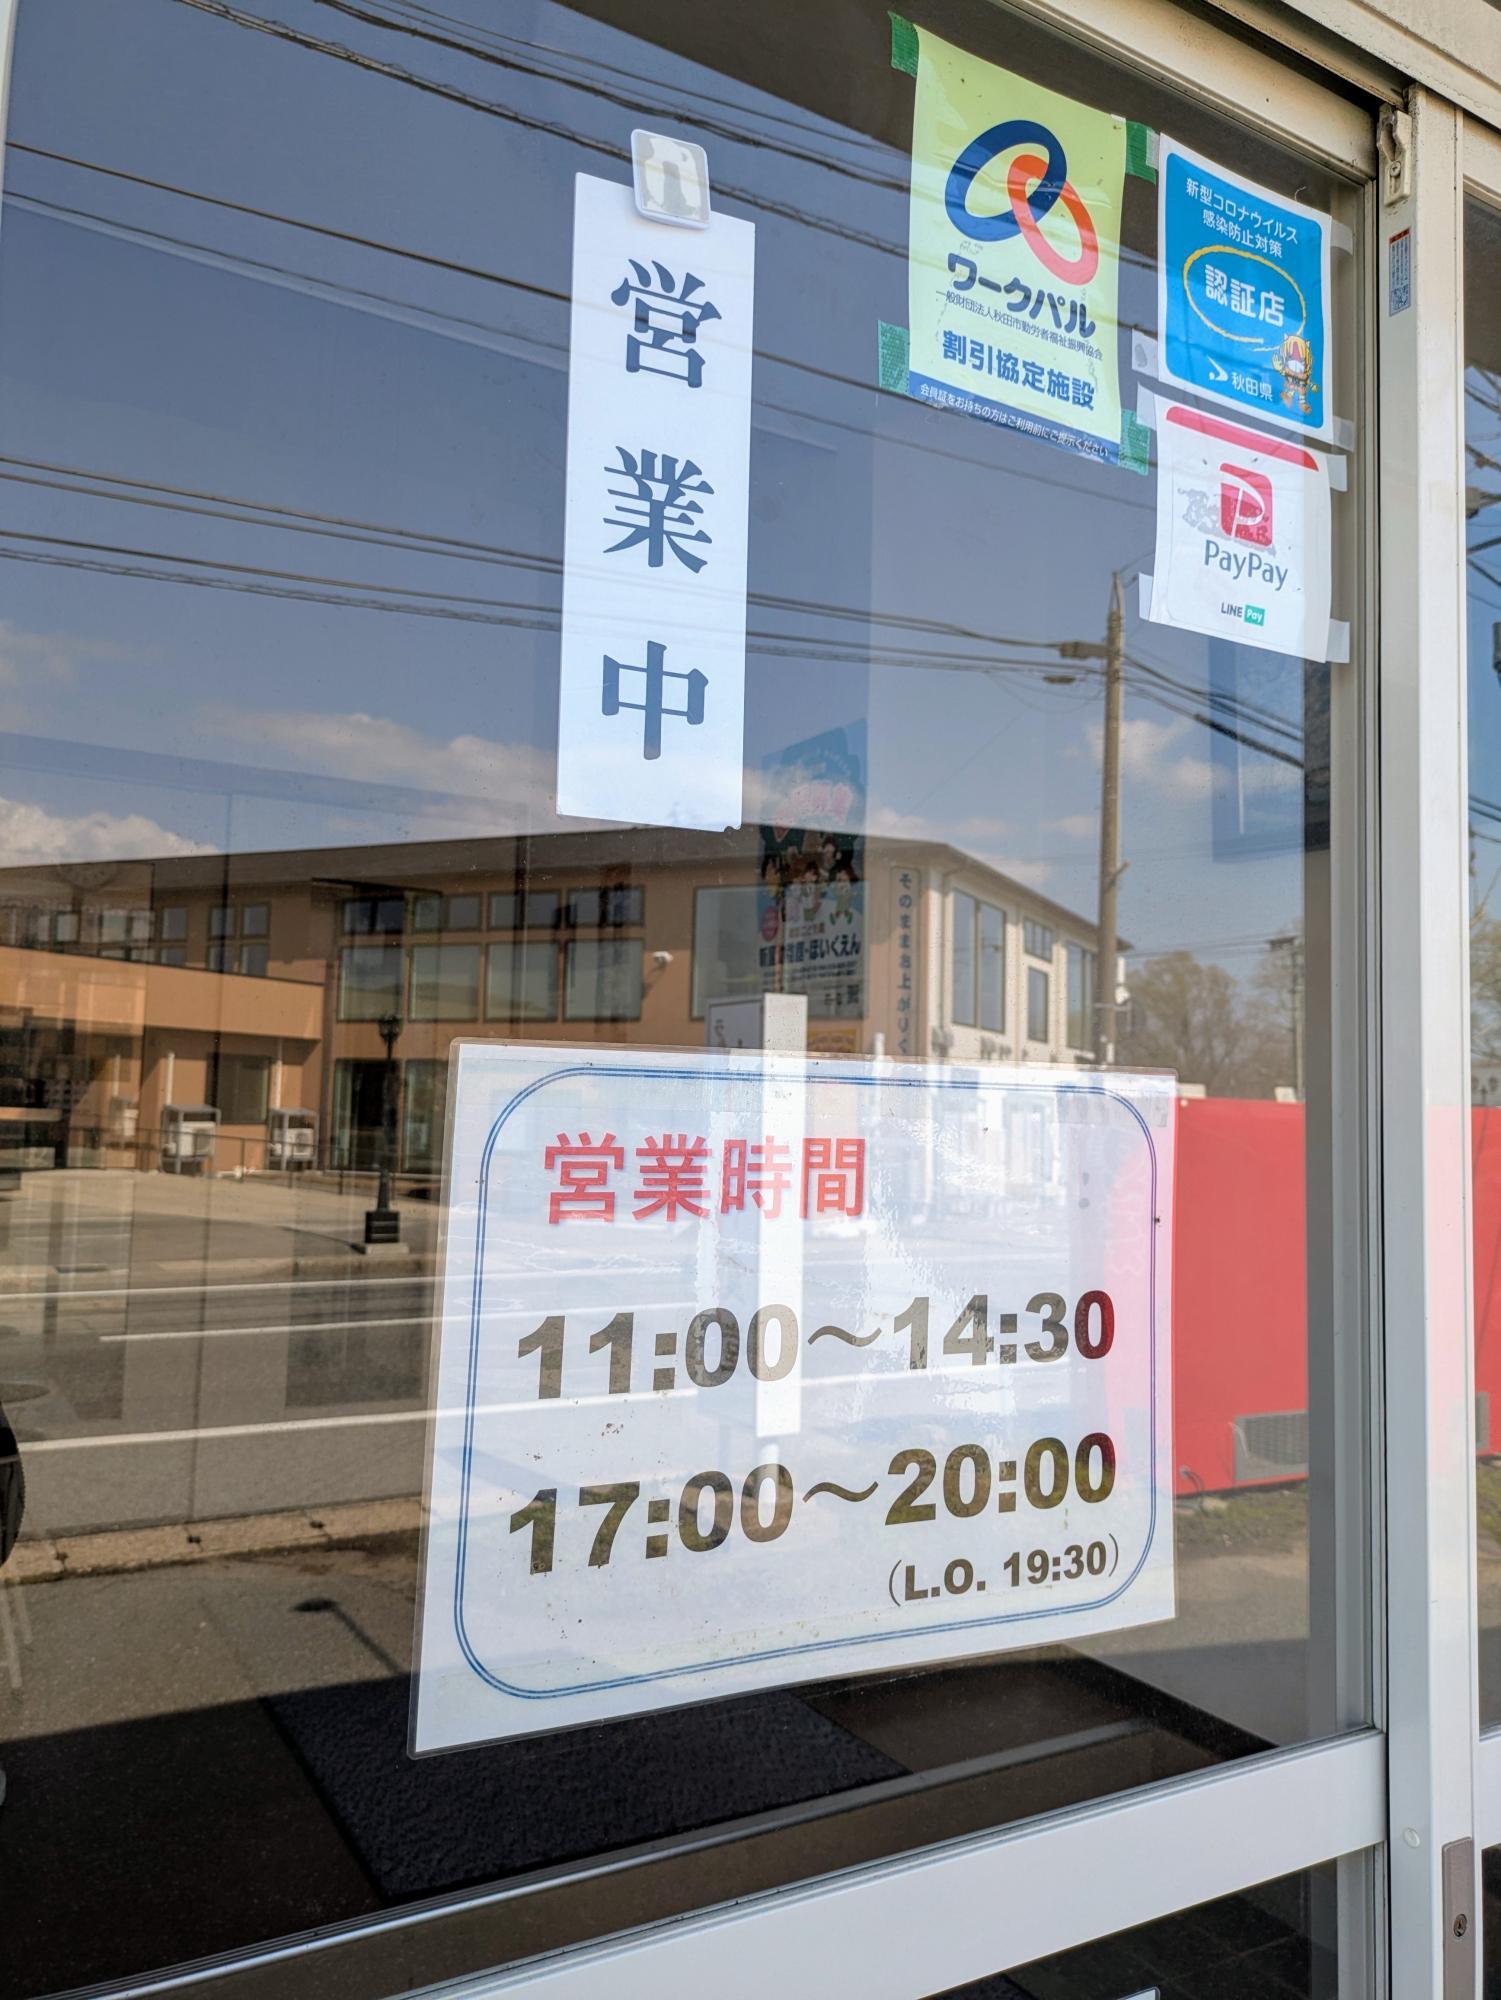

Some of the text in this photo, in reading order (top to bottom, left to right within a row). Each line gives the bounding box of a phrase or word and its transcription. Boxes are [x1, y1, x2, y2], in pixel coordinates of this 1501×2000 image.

[1186, 178, 1298, 244] 新型コロナウイルス
[1203, 209, 1283, 258] 感染防止対策
[948, 253, 1096, 338] ワークパル
[1204, 264, 1284, 328] 認証店
[943, 330, 1095, 411] 割引協定施設
[1231, 372, 1273, 402] 秋田県
[920, 384, 1109, 457] 会員証をお持ちの方はご利用前にご提示ください
[602, 258, 722, 760] 営業中
[1204, 539, 1288, 592] PayPay
[1221, 602, 1264, 622] LINE Pay
[544, 1132, 867, 1225] 営業時間
